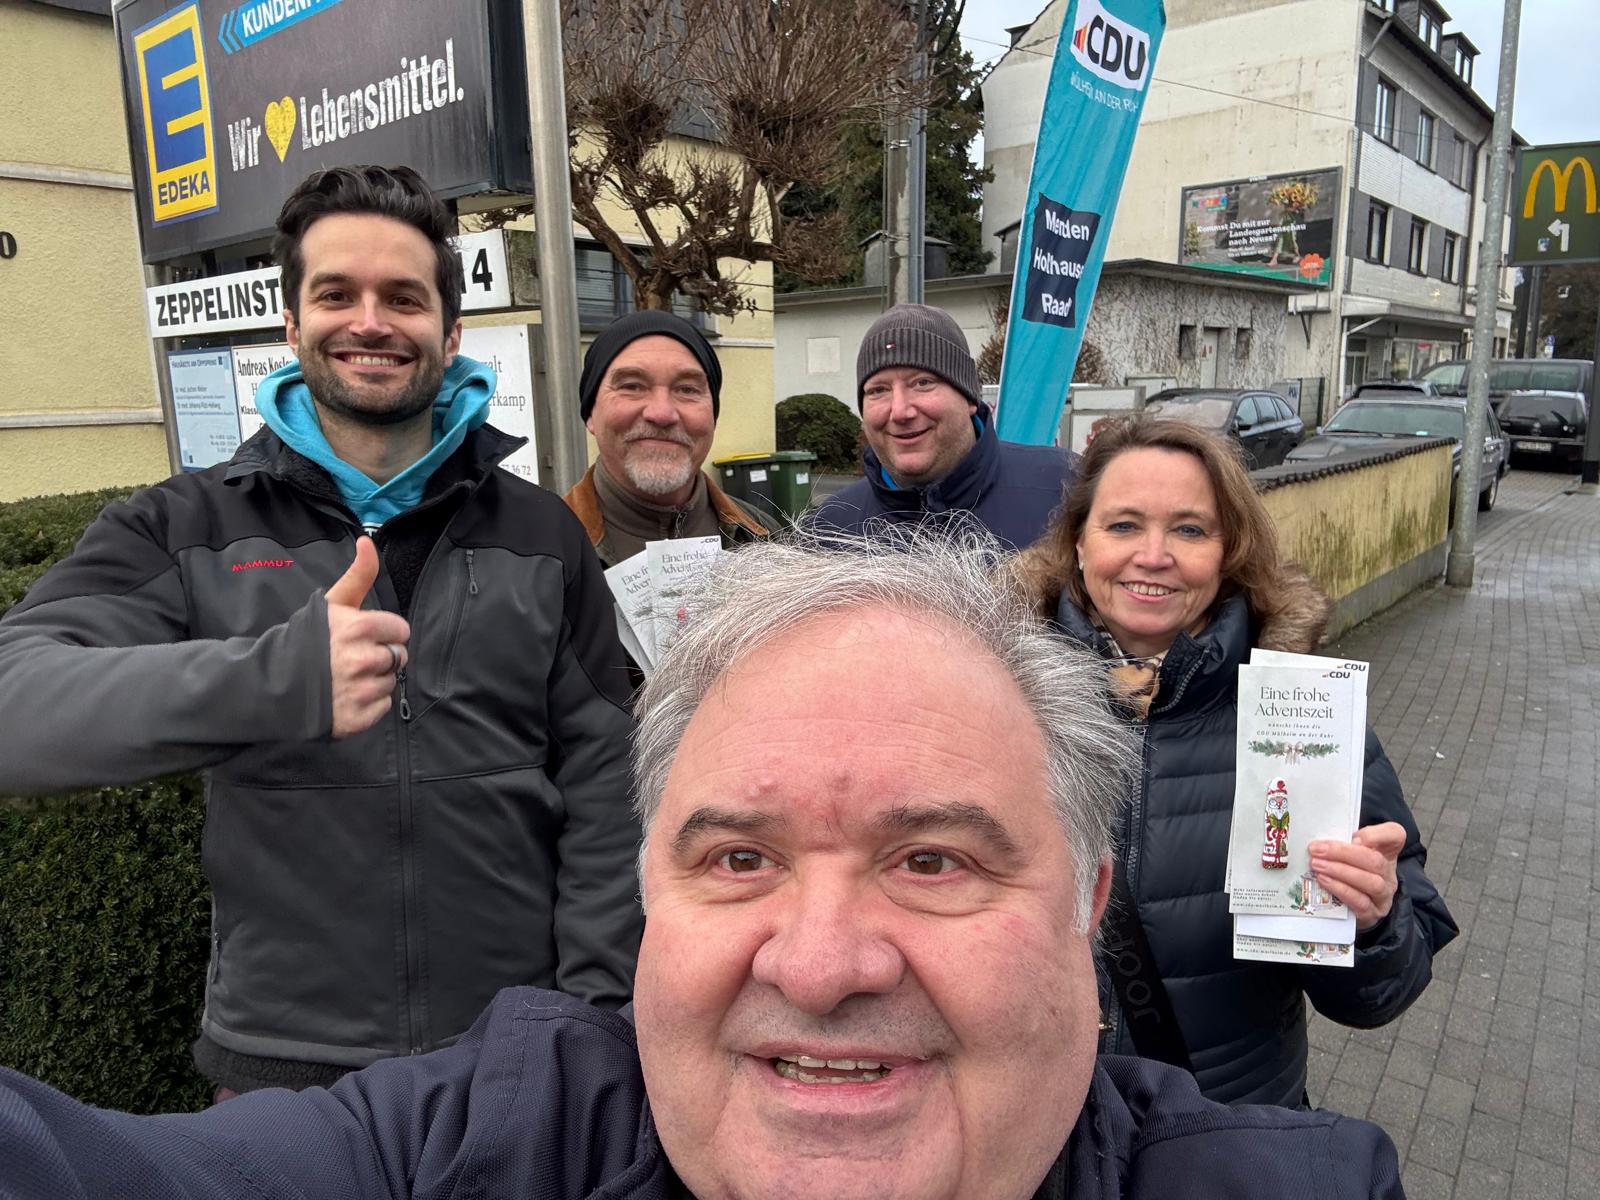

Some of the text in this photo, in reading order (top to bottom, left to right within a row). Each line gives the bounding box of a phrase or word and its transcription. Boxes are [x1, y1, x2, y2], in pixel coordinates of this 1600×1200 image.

[242, 0, 321, 38] KUNDEN
[1087, 14, 1146, 81] CDU
[228, 37, 465, 172] Wir Lebensmittel.
[158, 171, 210, 206] EDEKA
[237, 358, 268, 377] Andreas
[232, 559, 294, 572] MAMMUT
[1329, 671, 1351, 679] CDU
[1344, 663, 1366, 672] CDU
[1260, 686, 1331, 702] Eine frohe
[1254, 702, 1334, 720] Adventszeit
